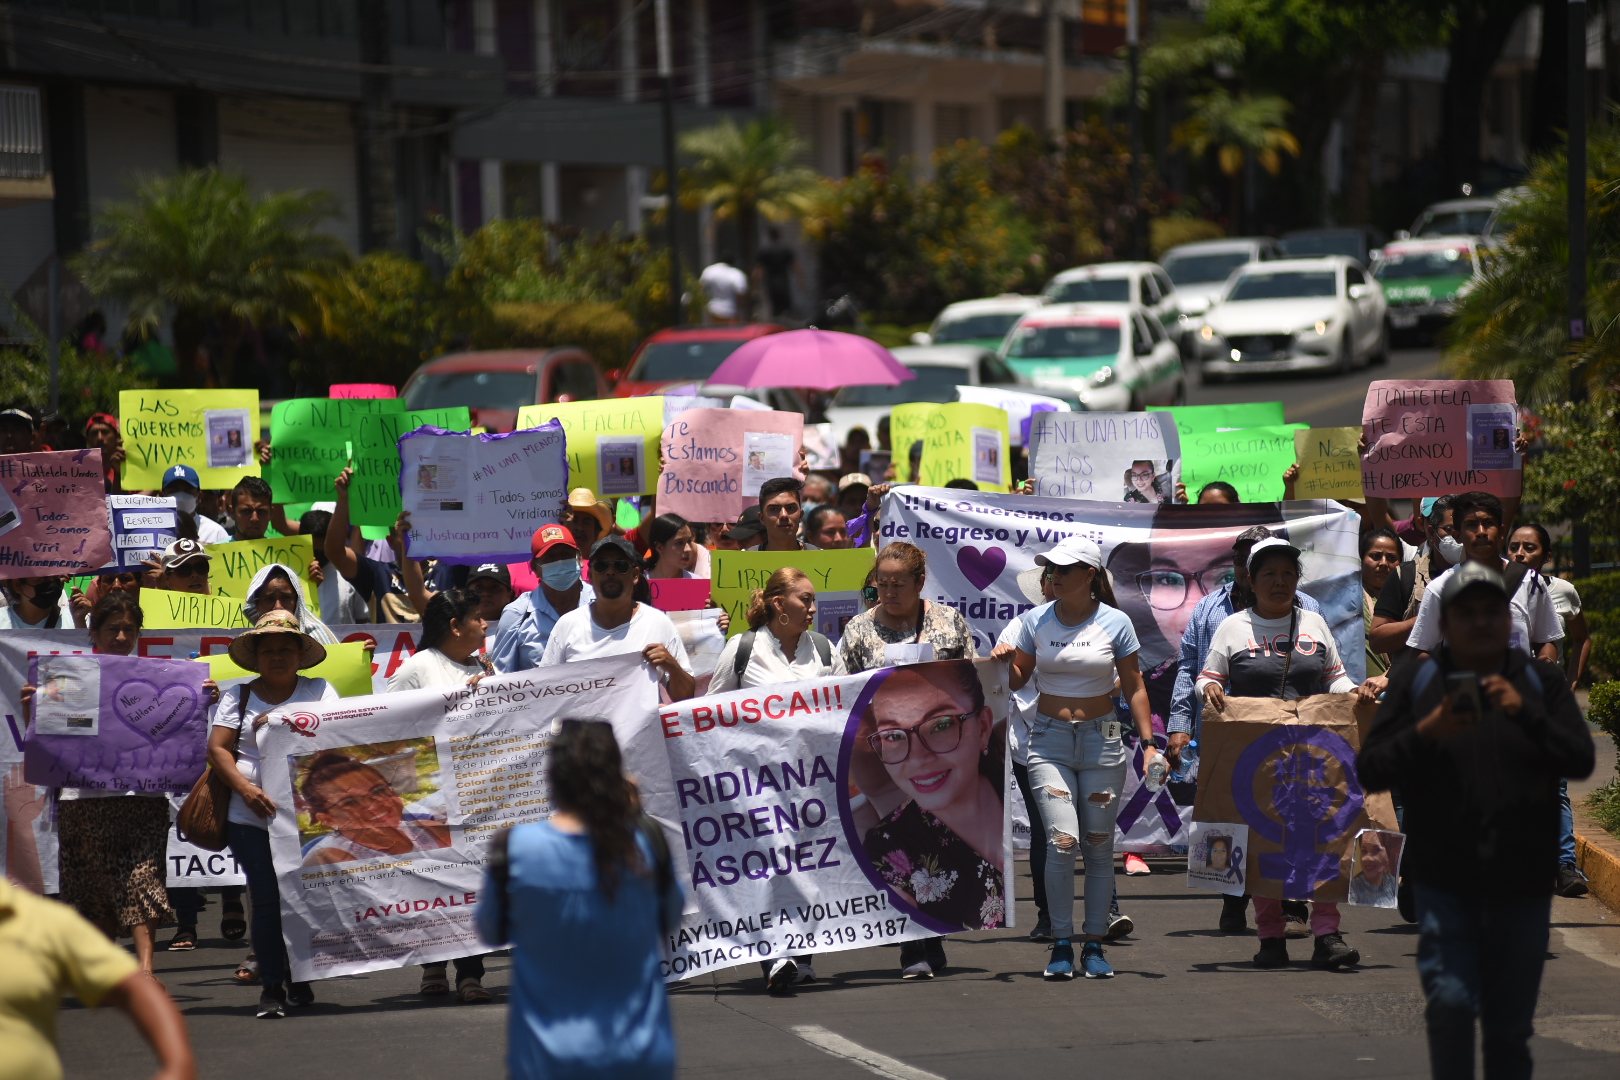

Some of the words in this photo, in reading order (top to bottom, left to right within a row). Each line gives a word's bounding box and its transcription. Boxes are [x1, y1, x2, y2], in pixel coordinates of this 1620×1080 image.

[140, 398, 179, 416] LAS
[126, 418, 204, 437] QUEREMOS
[582, 409, 647, 431] FALTA
[1366, 417, 1392, 434] TE
[1402, 416, 1446, 435] ESTA
[670, 421, 689, 439] Te
[1084, 419, 1118, 443] UNA
[137, 443, 195, 467] VIVAS
[499, 452, 521, 469] UNA
[523, 433, 560, 457] MENOS
[667, 438, 738, 463] Estamos
[1367, 442, 1454, 464] BUSCANDO
[1055, 453, 1093, 476] NOS
[1217, 462, 1269, 479] APOYO
[1313, 460, 1356, 474] FALTA
[531, 489, 563, 501] somos
[30, 505, 69, 521] Todos
[955, 501, 1075, 522] Queremos
[124, 517, 163, 526] RESPETO
[120, 535, 149, 546] HACIA
[473, 531, 498, 543] para
[881, 521, 909, 538] de
[916, 522, 1010, 544] Regreso
[1014, 528, 1030, 546] y
[813, 567, 832, 589] Y
[1050, 640, 1067, 648] NEW
[1071, 640, 1091, 648] YORK
[442, 679, 535, 702] VIRIDIANA
[444, 693, 526, 714] MORENO
[531, 677, 616, 699] VÁSQUEZ
[119, 695, 141, 709] Nos
[691, 685, 843, 733] BUSCA!!!
[322, 709, 357, 718] COMISIÓN
[358, 705, 388, 713] ESTATAL
[334, 712, 373, 720] BÚSQUEDA
[482, 728, 515, 738] mujer
[451, 744, 480, 752] Edad
[483, 736, 521, 748] actual:
[452, 752, 486, 762] Fecha
[490, 748, 504, 756] de
[463, 762, 476, 770] de
[480, 757, 508, 768] junio
[455, 766, 506, 780] Estatura:
[456, 779, 486, 788] Color
[507, 772, 534, 780] ojos:
[110, 777, 131, 790] Por
[458, 788, 488, 798] Color
[508, 780, 532, 790] piel:
[459, 795, 506, 806] Cabello:
[508, 789, 542, 800] negro,
[460, 806, 494, 816] Lugar
[464, 824, 498, 834] Fecha
[501, 820, 516, 828] de
[302, 868, 338, 881] Señas
[341, 859, 413, 875] particulares:
[302, 880, 336, 890] Lunar
[339, 876, 354, 884] en
[356, 874, 366, 882] la
[369, 871, 399, 881] nariz,
[400, 865, 441, 876] tatuaje
[444, 862, 458, 870] en
[356, 892, 477, 922] ¡AYÚDALE
[669, 911, 772, 953] ¡AYÚDALE
[779, 908, 792, 925] A
[797, 893, 887, 923] VOLVER!
[659, 940, 778, 978] CONTACTO:
[785, 932, 816, 950] 228
[822, 926, 856, 946] 319
[862, 917, 908, 940] 3187
